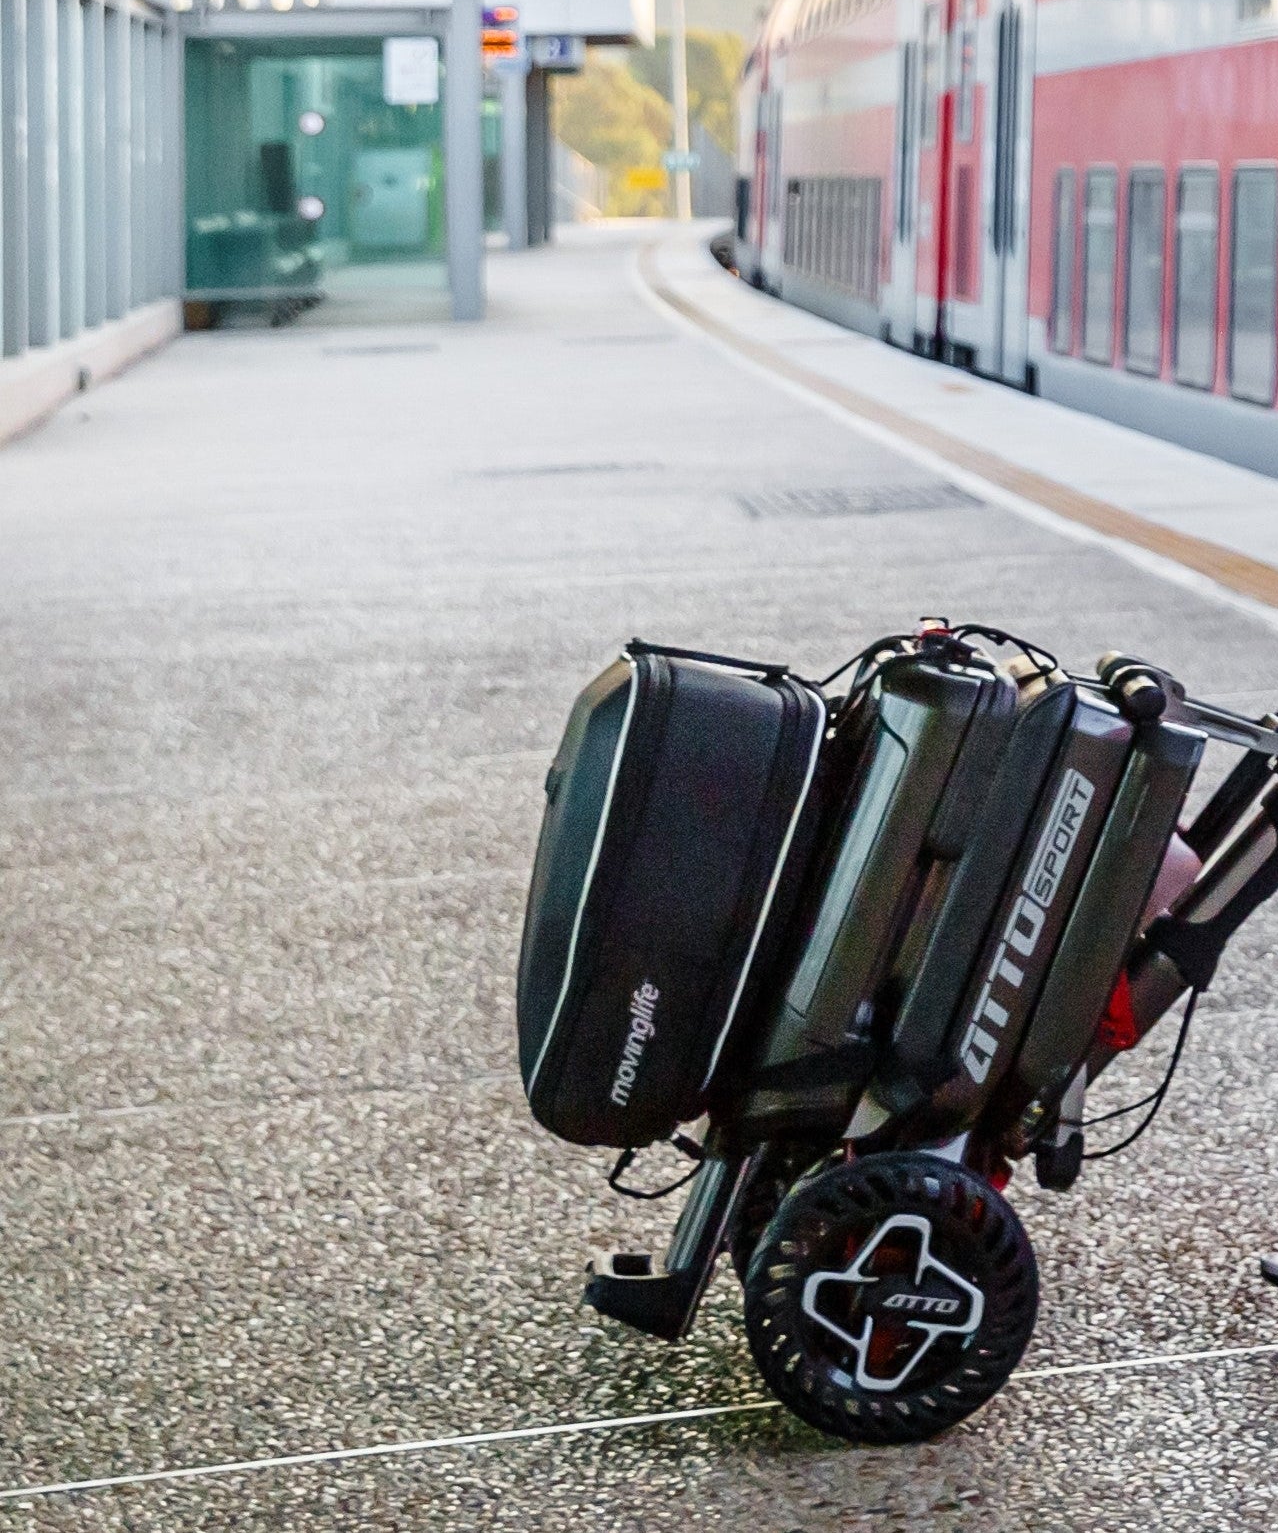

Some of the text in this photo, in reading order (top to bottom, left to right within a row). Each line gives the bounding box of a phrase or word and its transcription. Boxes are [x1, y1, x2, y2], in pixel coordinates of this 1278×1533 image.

[960, 777, 1089, 1084] ATTO SPORT
[610, 980, 660, 1107] movinglife
[882, 1293, 960, 1313] ATTO
